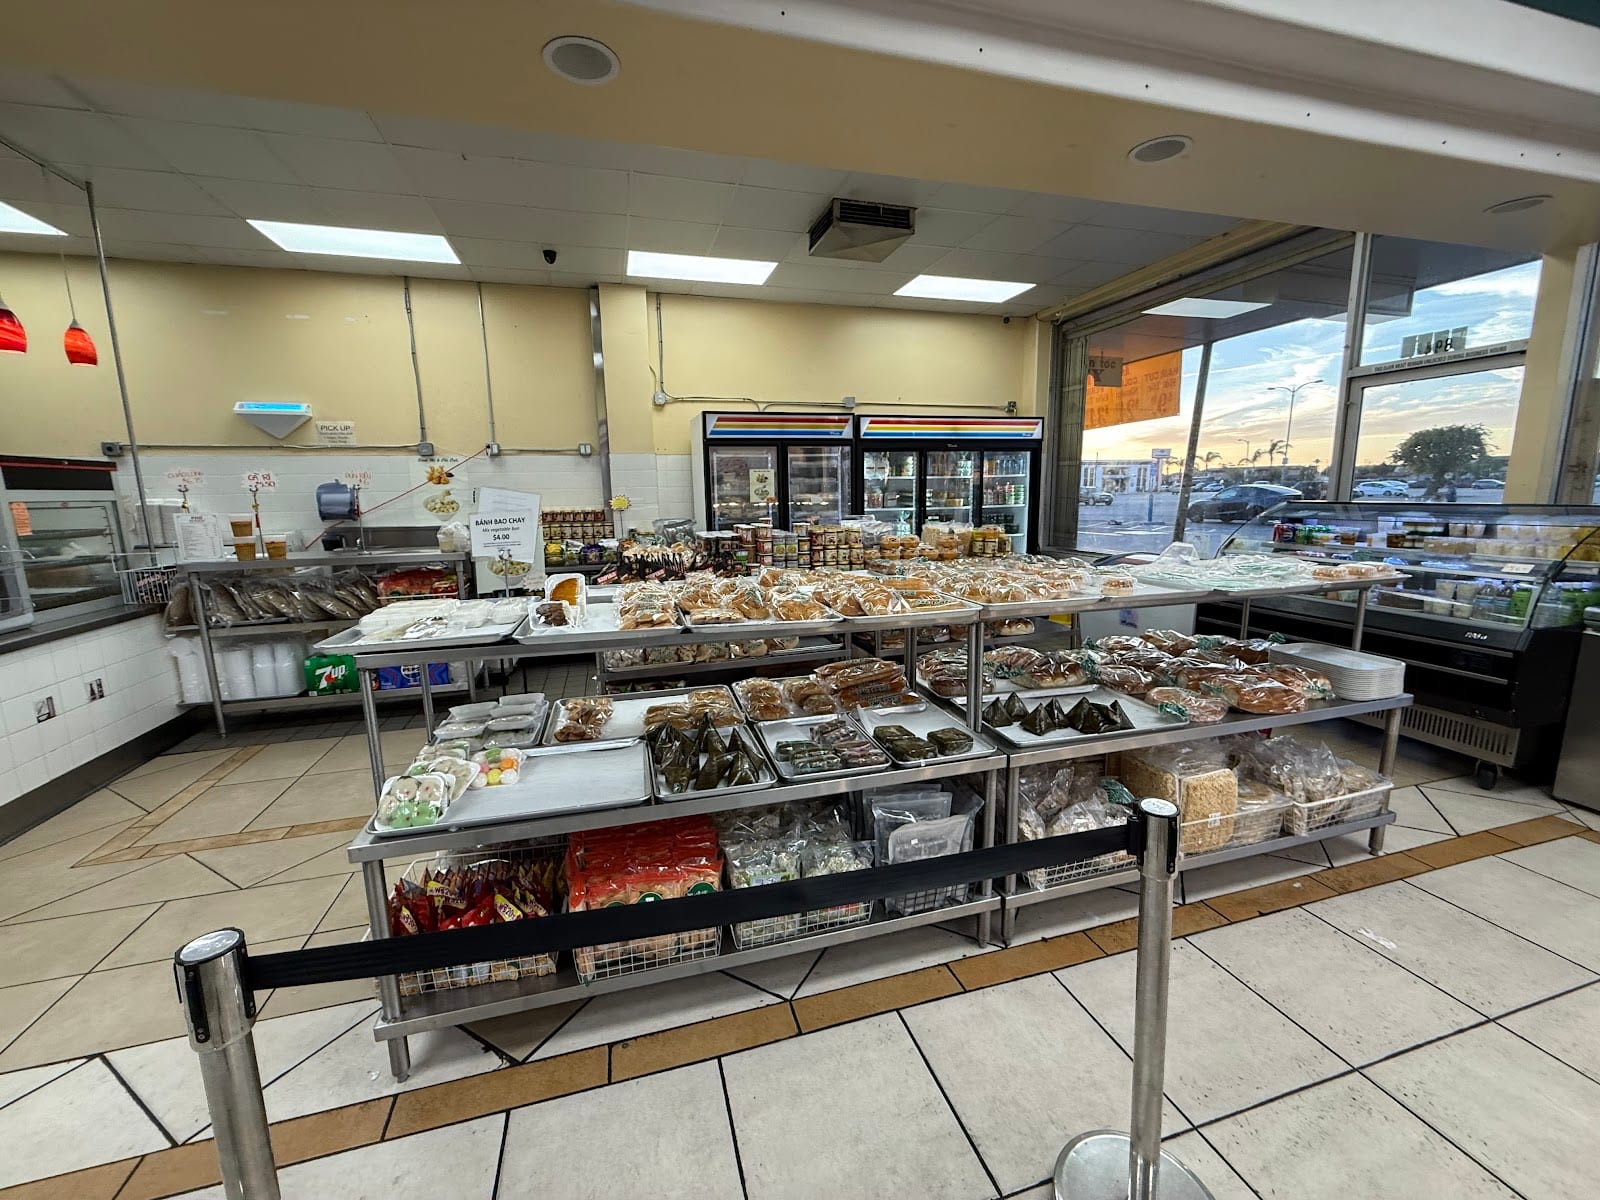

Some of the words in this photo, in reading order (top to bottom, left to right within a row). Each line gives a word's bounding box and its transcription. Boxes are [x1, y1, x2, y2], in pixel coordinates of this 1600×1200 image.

[475, 518, 493, 526] BÁNH
[494, 517, 508, 525] BAO
[508, 516, 526, 524] CHAY
[493, 533, 510, 541] $4.00
